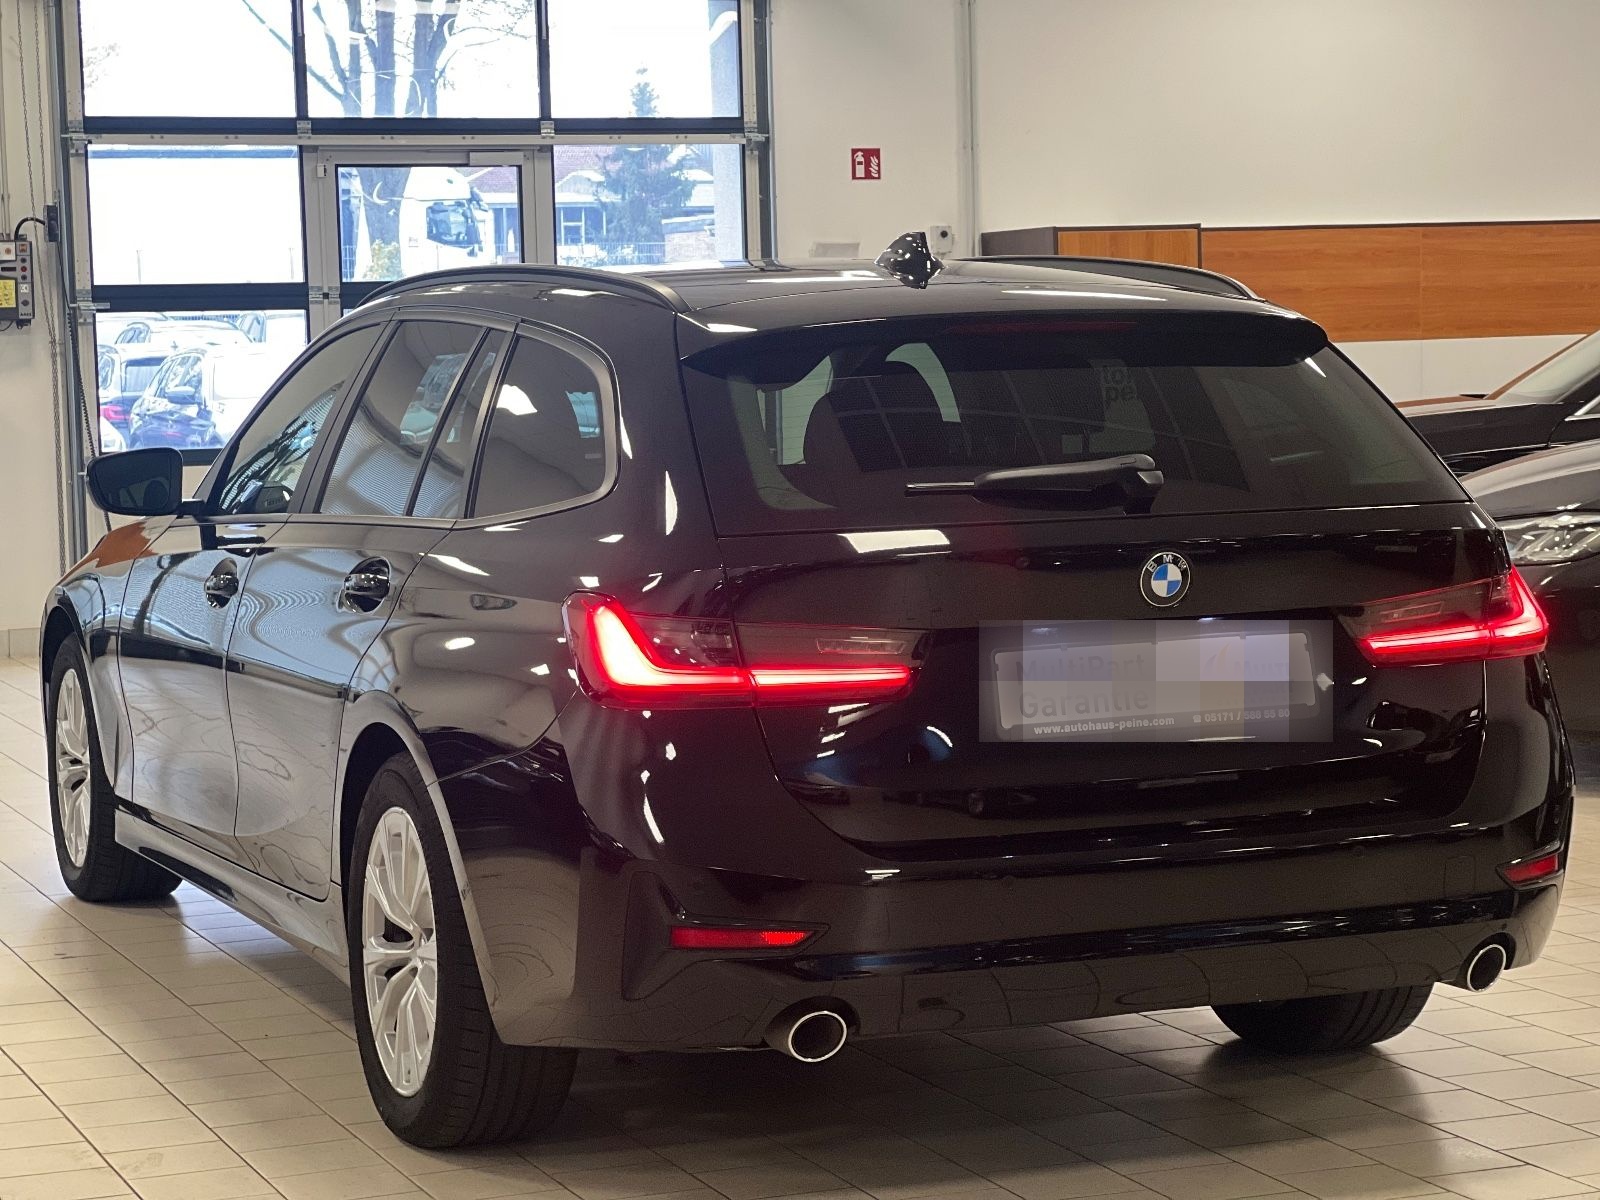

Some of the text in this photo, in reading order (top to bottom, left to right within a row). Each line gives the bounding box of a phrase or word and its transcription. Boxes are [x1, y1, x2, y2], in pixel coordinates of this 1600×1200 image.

[1146, 554, 1187, 572] BMW
[1015, 654, 1145, 683] MultiPart
[1019, 690, 1150, 719] Garantie
[1033, 716, 1175, 735] www.autohaus-peine.com
[1204, 711, 1234, 722] 05171
